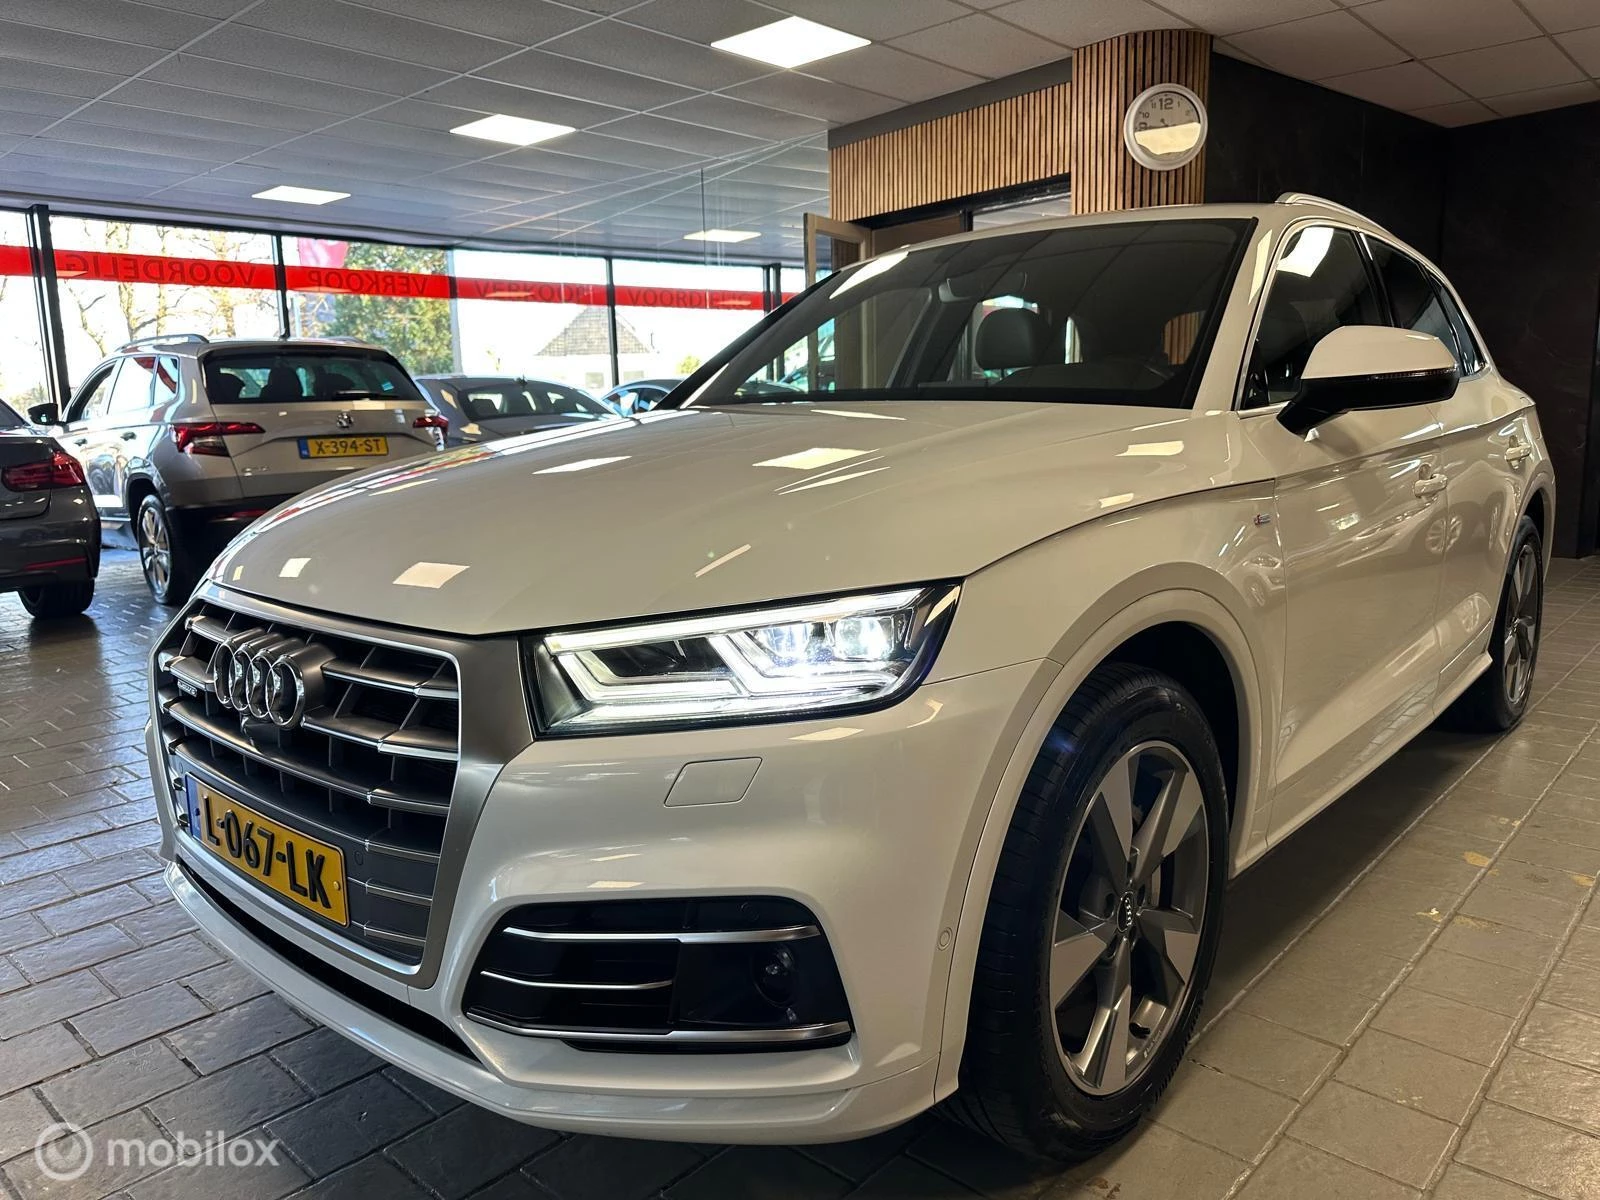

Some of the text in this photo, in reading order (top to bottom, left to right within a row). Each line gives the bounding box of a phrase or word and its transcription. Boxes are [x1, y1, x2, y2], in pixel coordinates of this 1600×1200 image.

[1158, 97, 1174, 111] 12
[1142, 111, 1150, 119] 10
[315, 438, 382, 455] X-394-ST
[202, 793, 332, 909] L-067-LK
